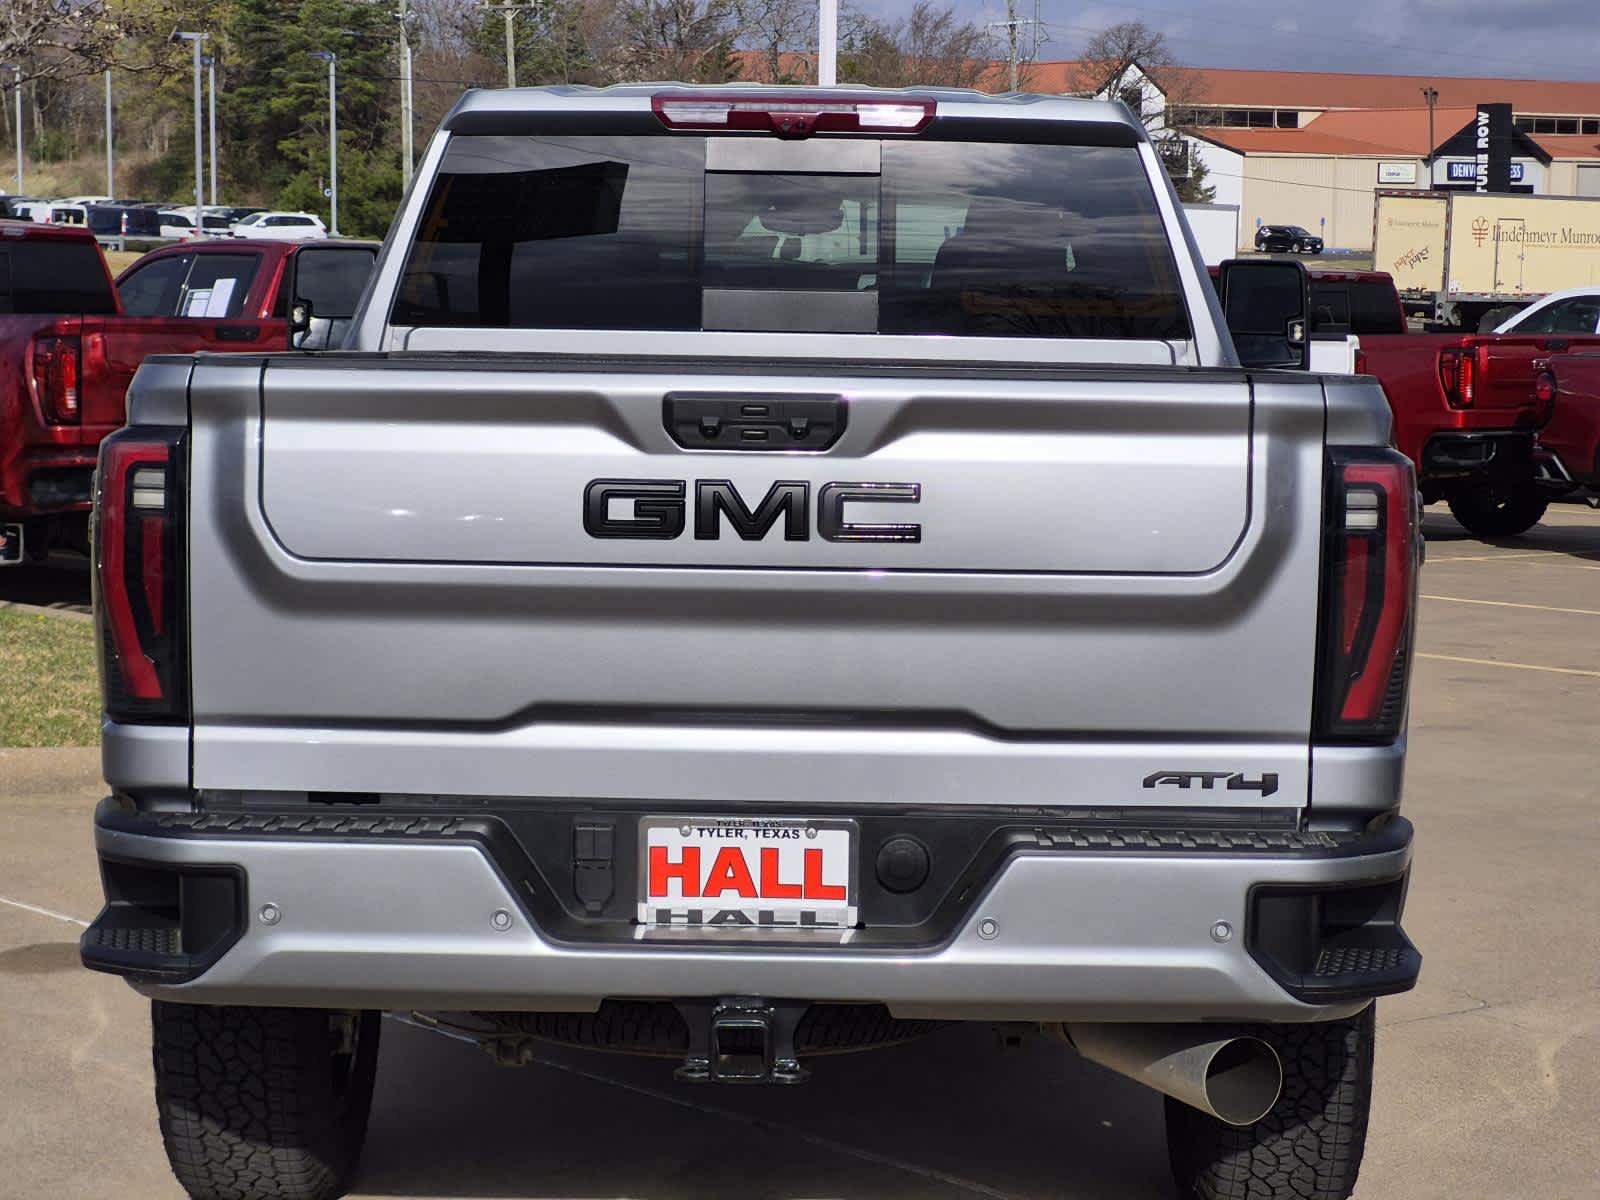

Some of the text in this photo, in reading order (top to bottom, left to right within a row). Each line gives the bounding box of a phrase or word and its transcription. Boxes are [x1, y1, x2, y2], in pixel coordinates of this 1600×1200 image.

[1477, 111, 1490, 149] ROW
[1453, 163, 1476, 177] DENV
[583, 478, 922, 543] GMC
[1143, 771, 1279, 798] AT4
[697, 828, 800, 840] TYLER, TEXAS
[649, 846, 847, 900] HALL
[656, 909, 839, 925] HALL
